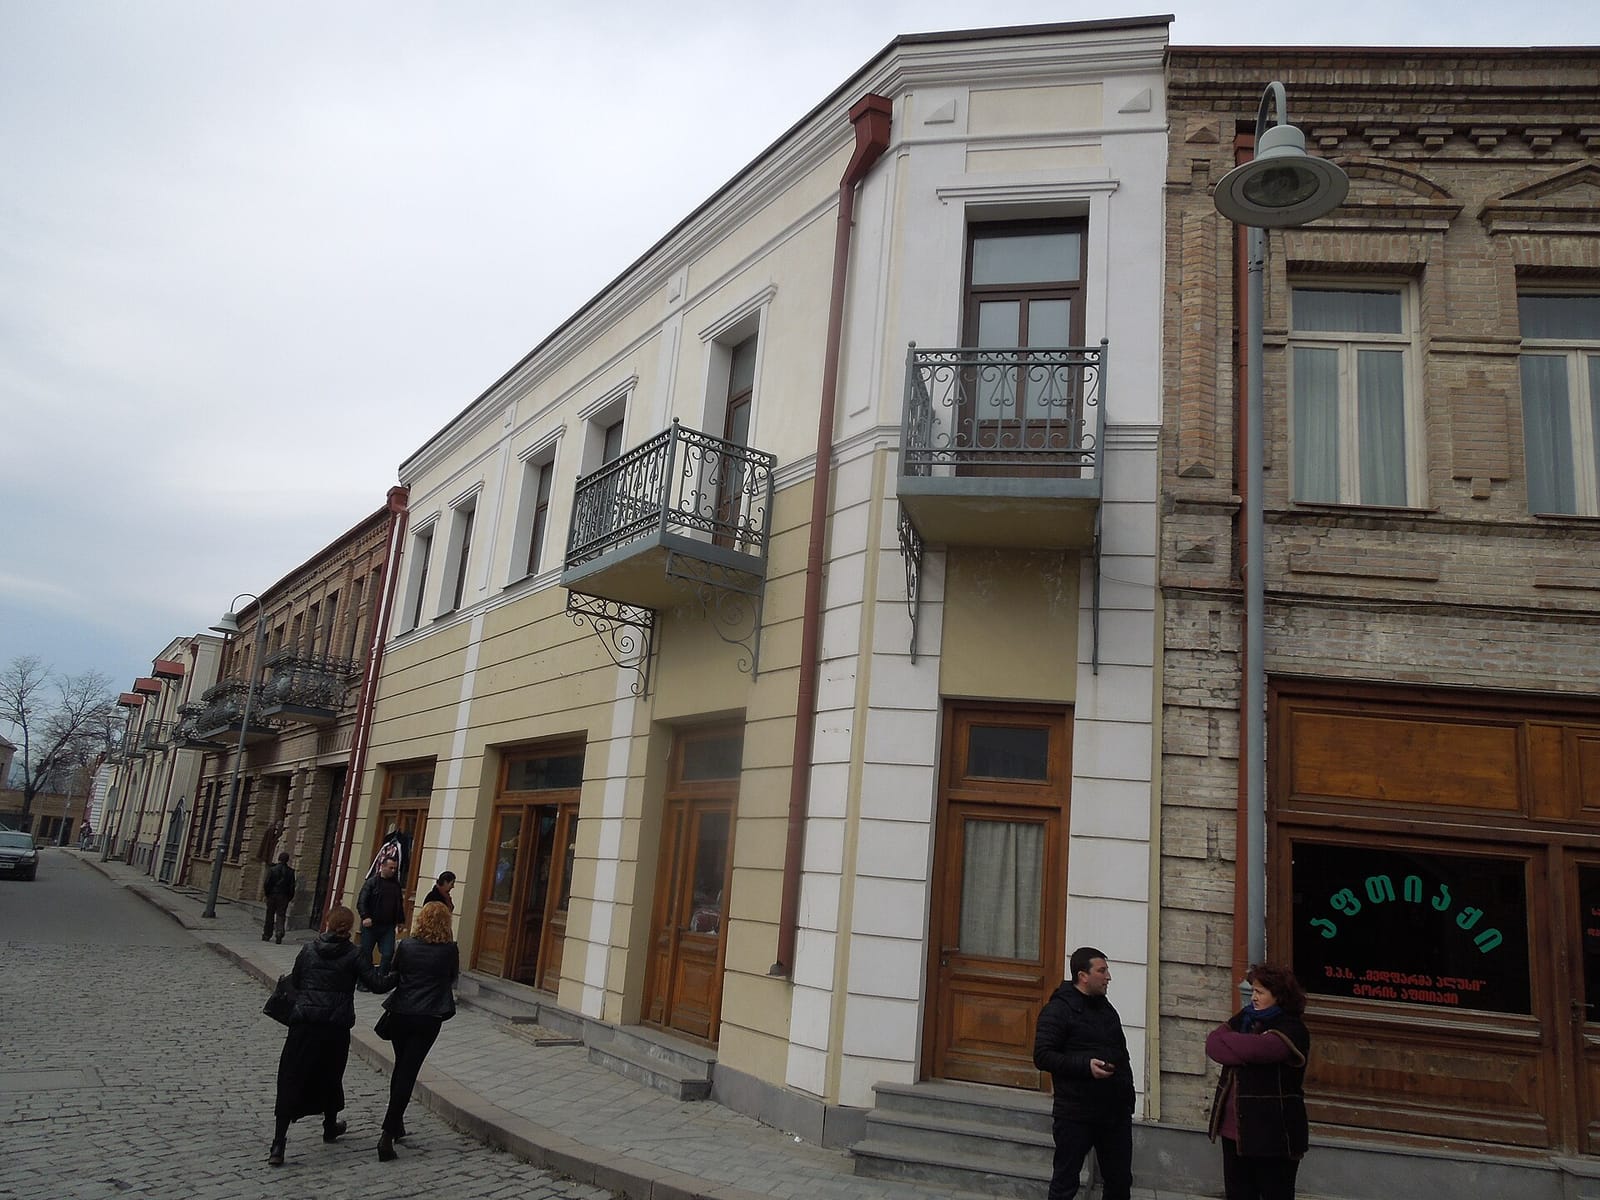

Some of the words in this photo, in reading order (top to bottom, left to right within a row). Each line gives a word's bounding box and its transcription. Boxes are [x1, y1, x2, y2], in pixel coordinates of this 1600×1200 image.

[1309, 874, 1503, 954] აფთიაქი
[1352, 983, 1398, 999] გორის
[1400, 988, 1460, 1005] აფთიაქი
